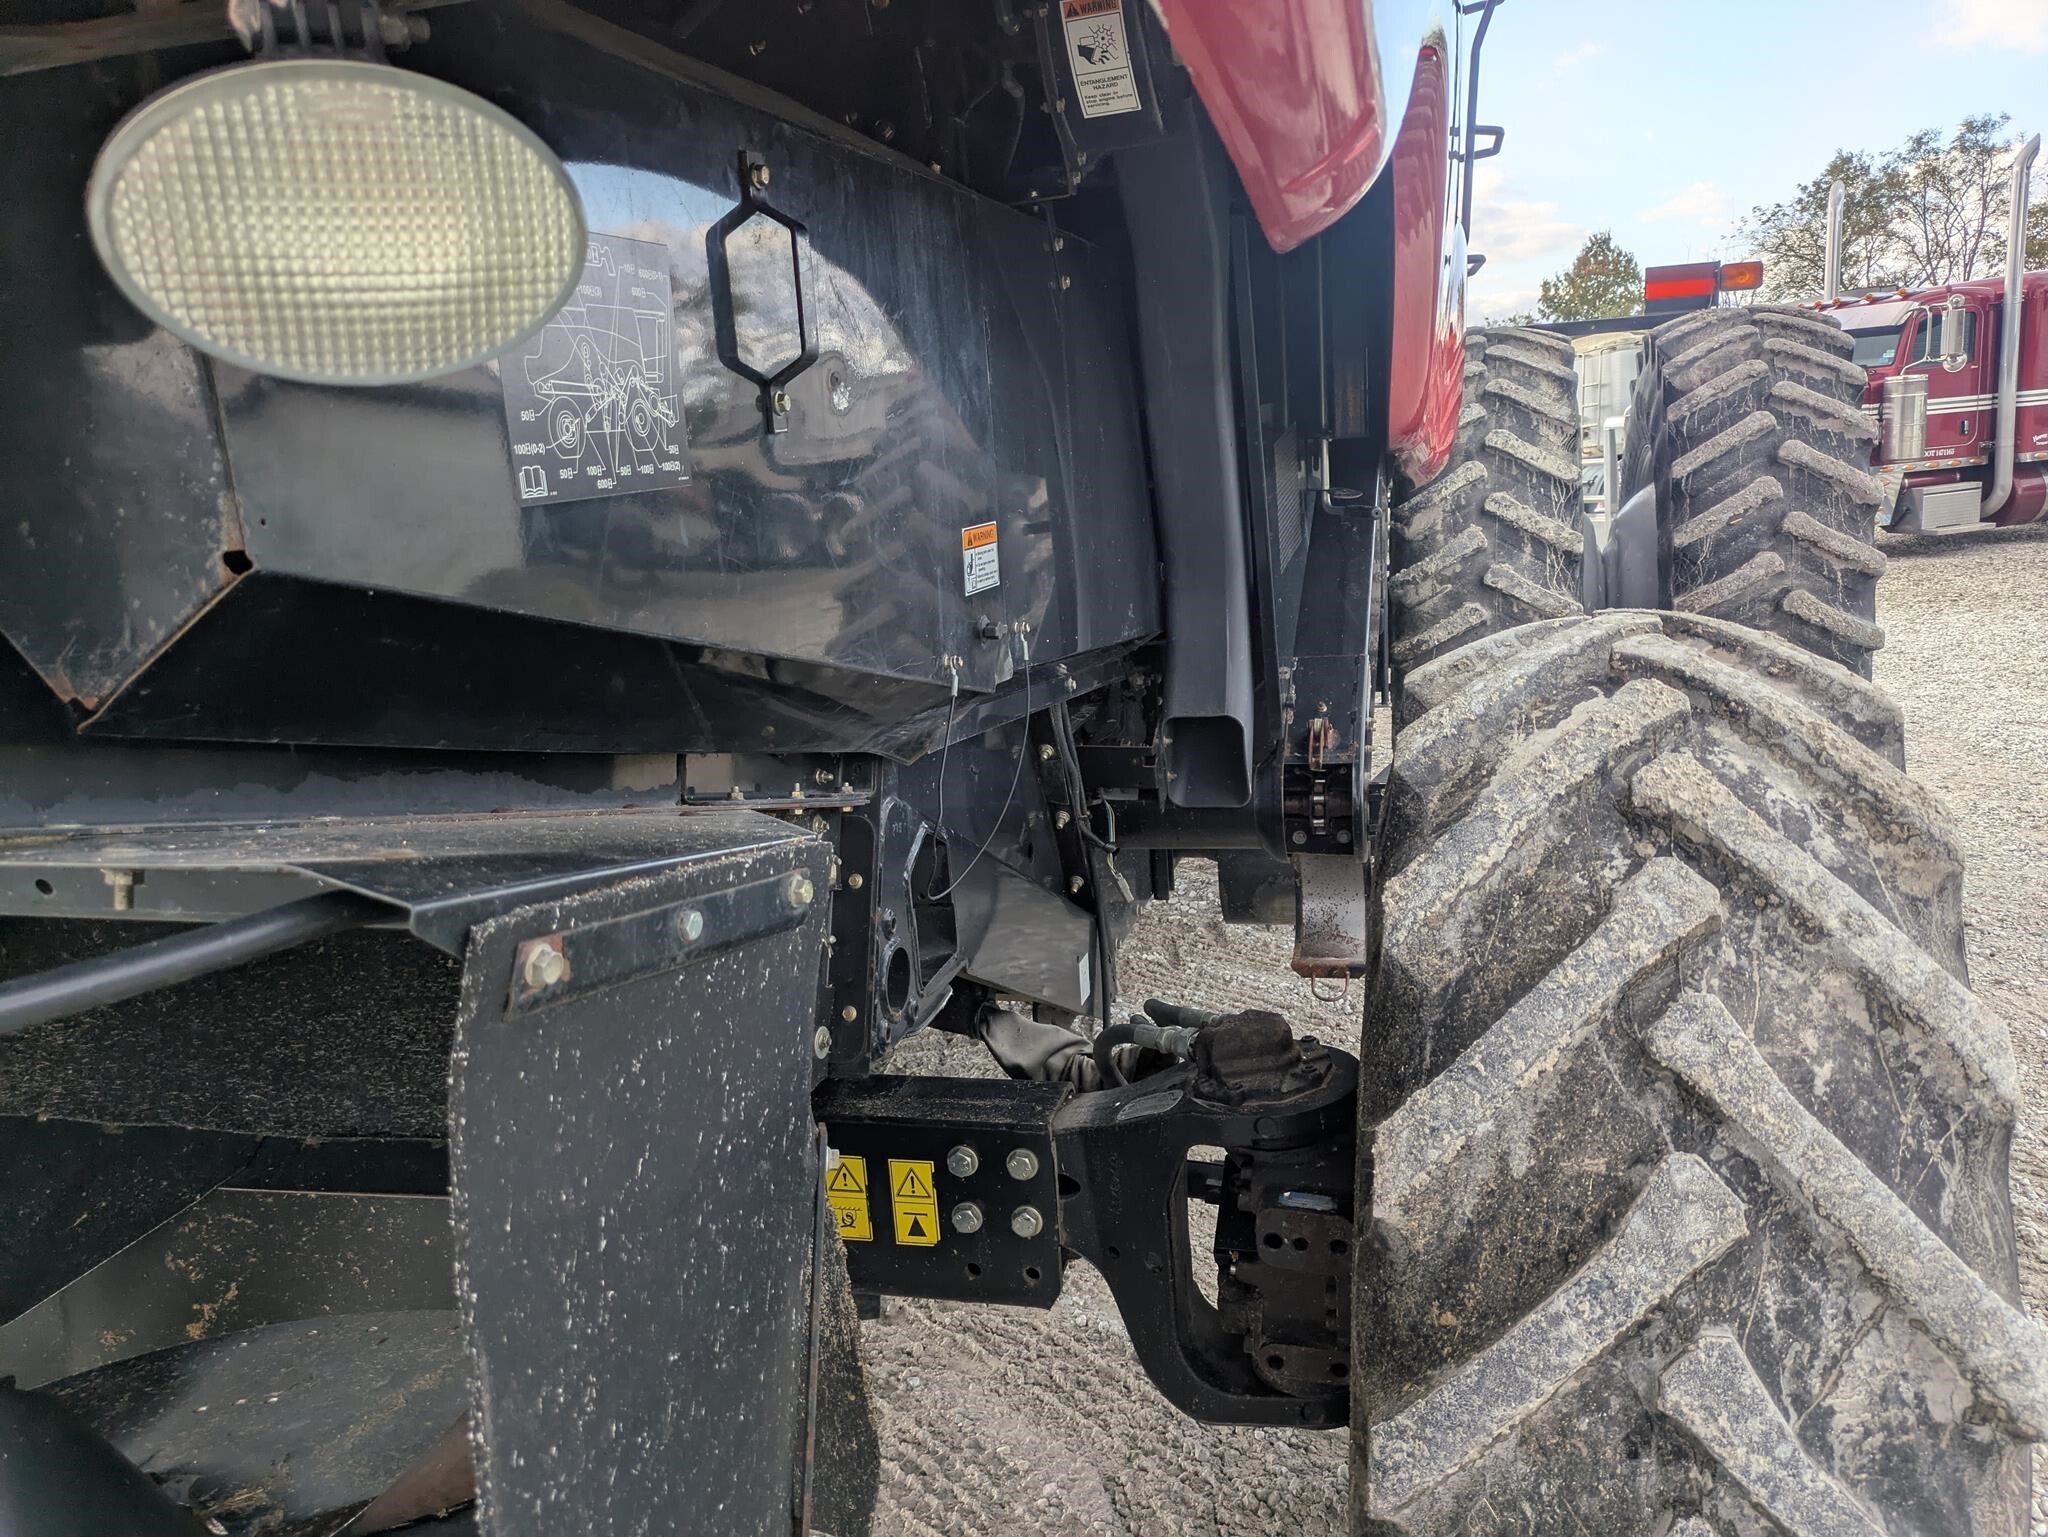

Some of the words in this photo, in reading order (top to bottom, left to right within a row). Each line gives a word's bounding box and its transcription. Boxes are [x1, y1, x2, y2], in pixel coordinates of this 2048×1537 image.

[1080, 0, 1117, 13] WARNING
[1080, 74, 1128, 87] ENTANGLEMENT
[1093, 81, 1119, 90] HAZARD
[973, 529, 994, 542] WARNING
